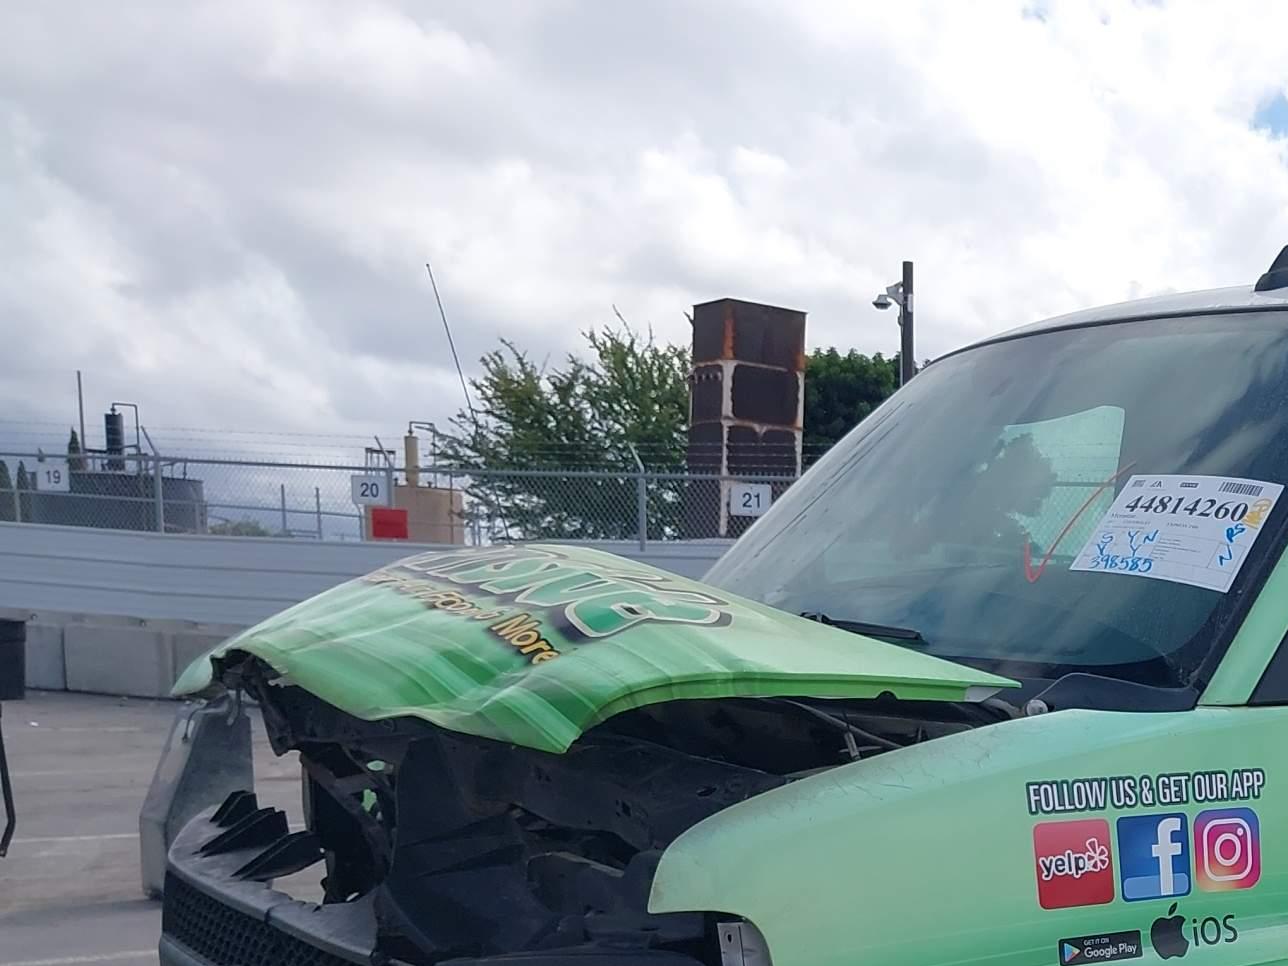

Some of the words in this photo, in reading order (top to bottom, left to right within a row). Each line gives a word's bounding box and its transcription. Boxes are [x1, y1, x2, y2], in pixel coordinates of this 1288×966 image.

[46, 469, 62, 485] 19
[360, 482, 380, 498] 20
[742, 492, 761, 508] 21
[1125, 495, 1249, 522] 44814260
[1028, 780, 1105, 812] FOLLOW
[1111, 778, 1136, 807] US
[1141, 777, 1153, 804] &
[1158, 775, 1189, 803] GET
[1194, 773, 1228, 800] OUR
[1231, 770, 1264, 798] APP
[1040, 850, 1088, 881] yelp
[1192, 914, 1239, 947] iOS
[1084, 945, 1118, 958] Google
[1119, 943, 1137, 955] Play
